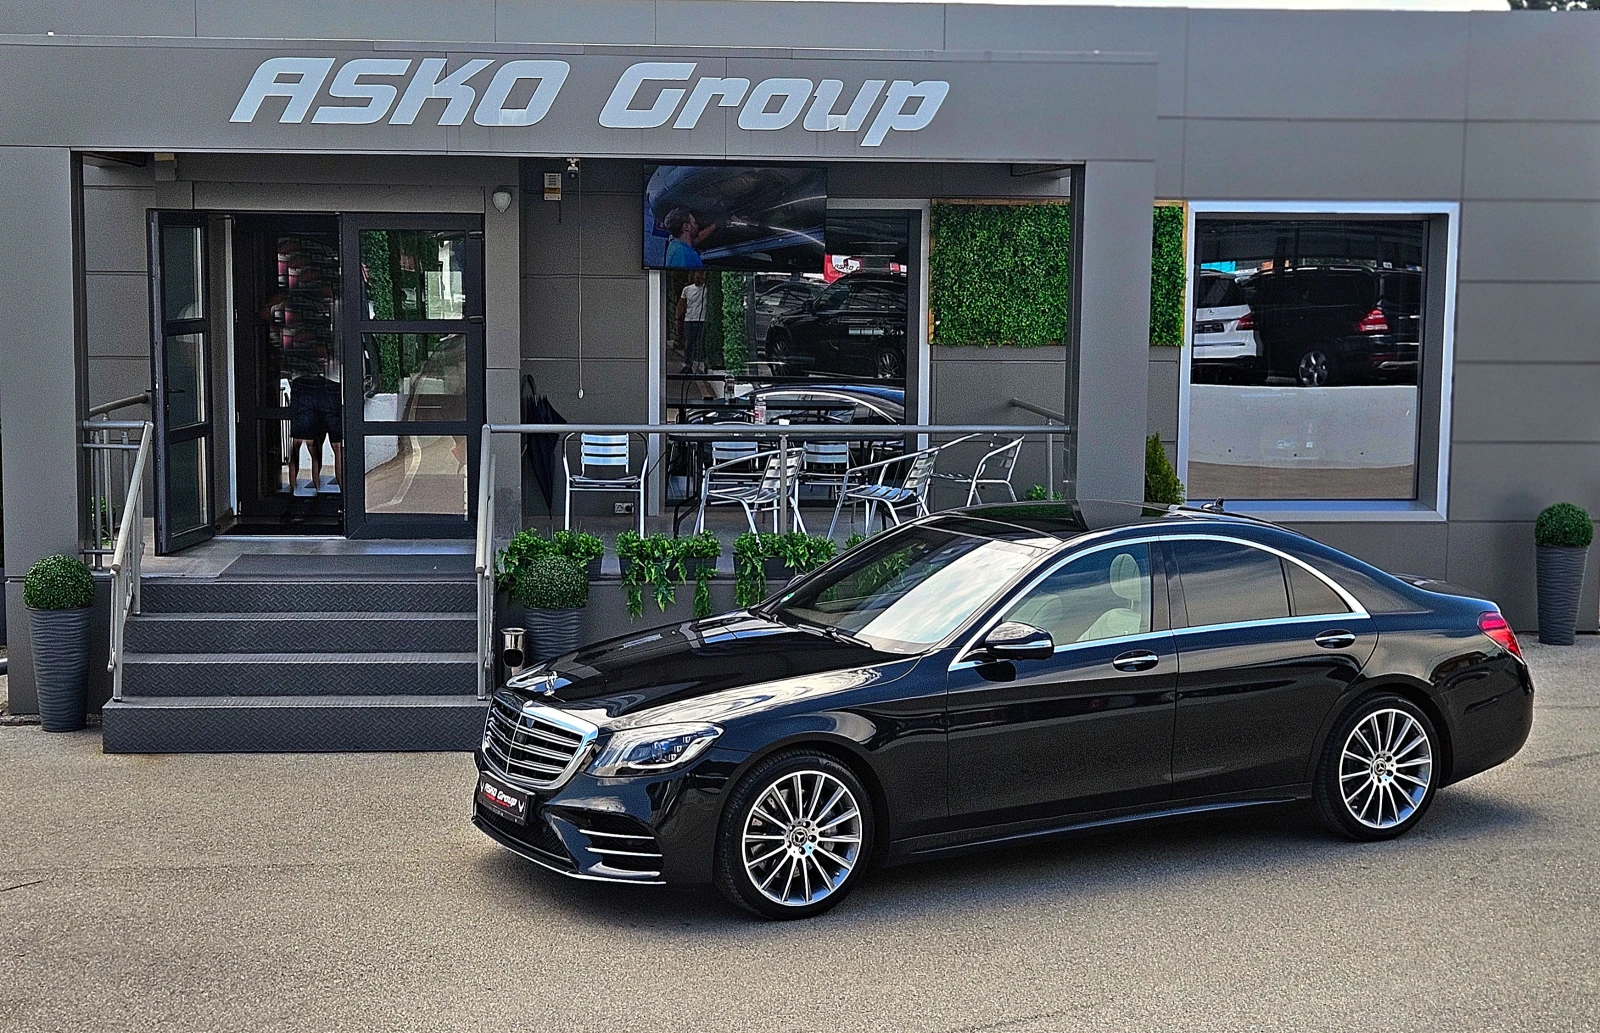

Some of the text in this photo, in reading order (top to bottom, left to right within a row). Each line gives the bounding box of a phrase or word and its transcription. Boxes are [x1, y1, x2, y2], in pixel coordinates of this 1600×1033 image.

[229, 57, 950, 147] ASKO Group
[496, 790, 518, 807] Group
